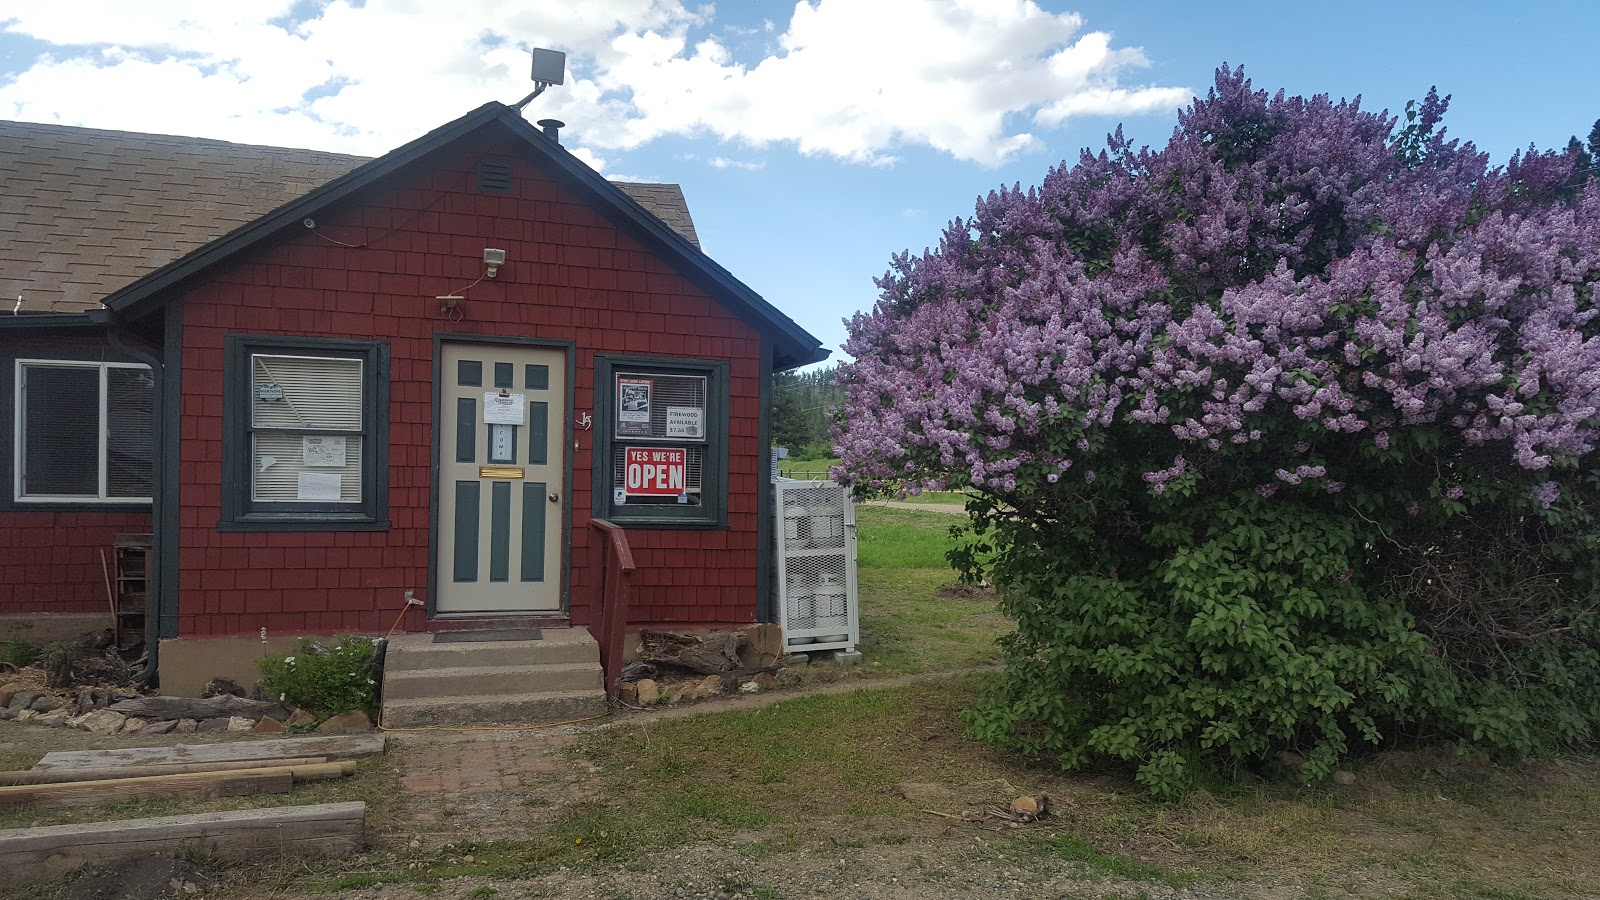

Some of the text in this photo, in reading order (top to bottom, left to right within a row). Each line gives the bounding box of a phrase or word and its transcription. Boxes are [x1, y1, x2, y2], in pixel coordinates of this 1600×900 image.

[631, 451, 681, 462] YES WE'RE
[628, 463, 682, 489] OPEN
